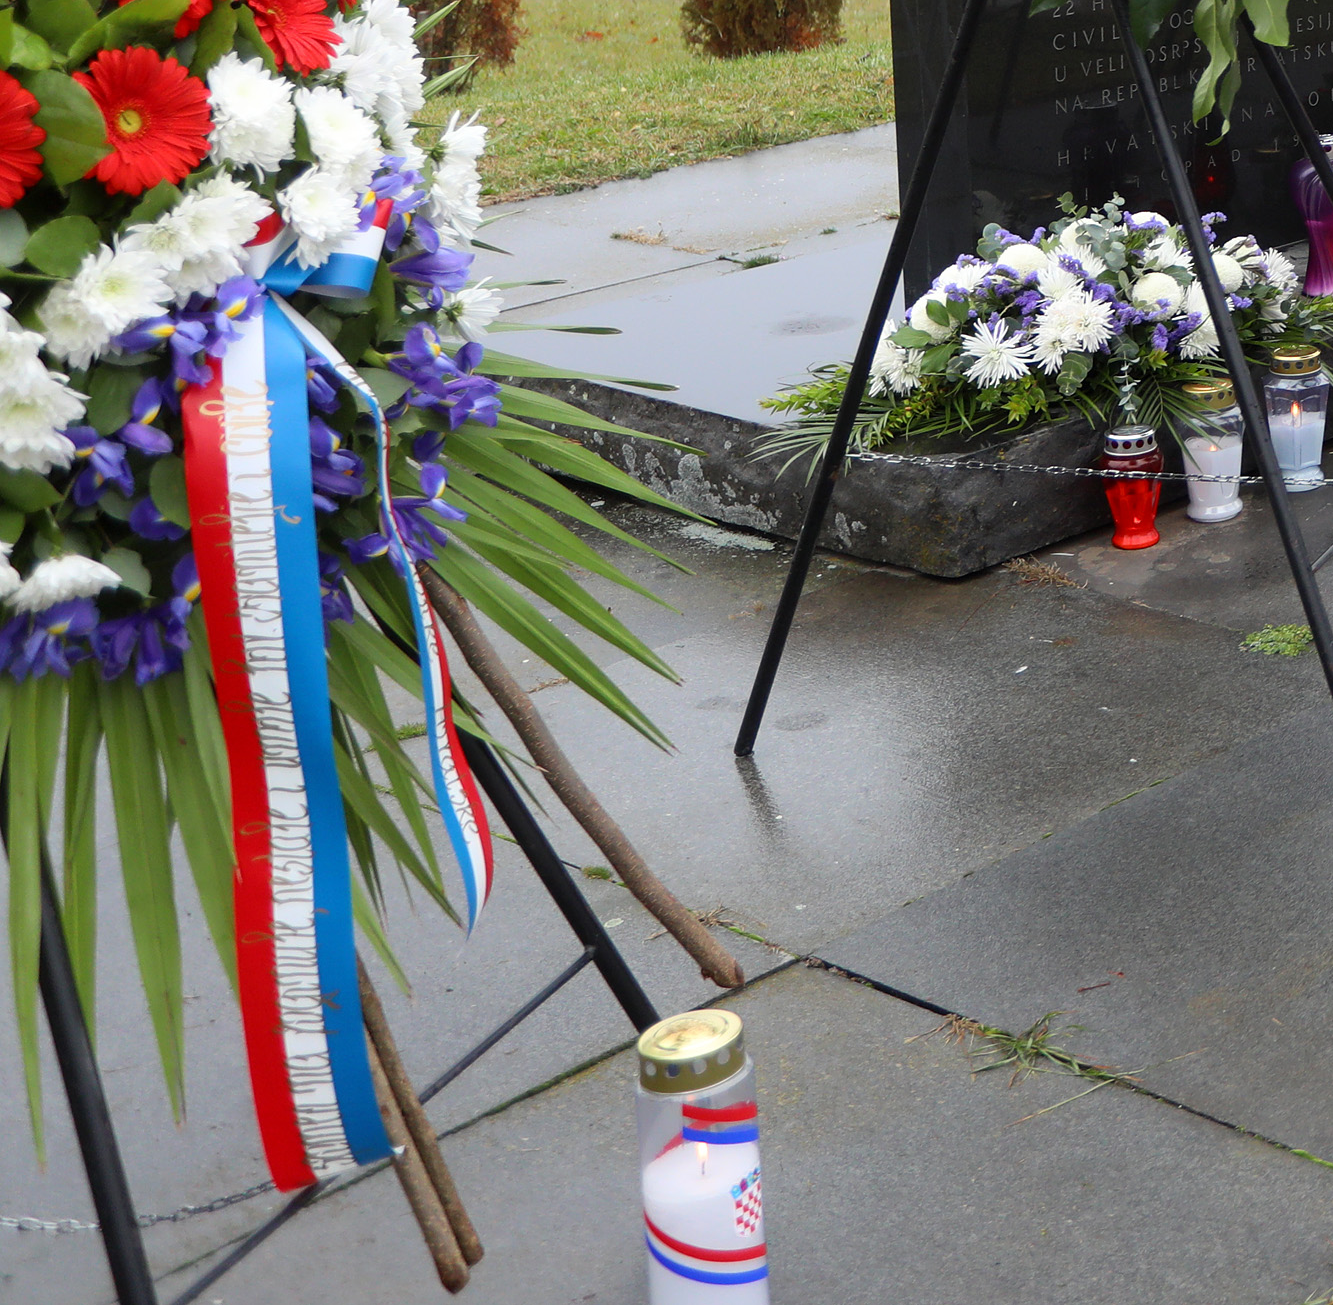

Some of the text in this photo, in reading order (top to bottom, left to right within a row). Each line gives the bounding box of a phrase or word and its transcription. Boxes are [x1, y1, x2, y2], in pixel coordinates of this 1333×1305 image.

[1051, 25, 1122, 52] CIVIL
[1054, 65, 1067, 83] U
[1055, 94, 1084, 116] NA
